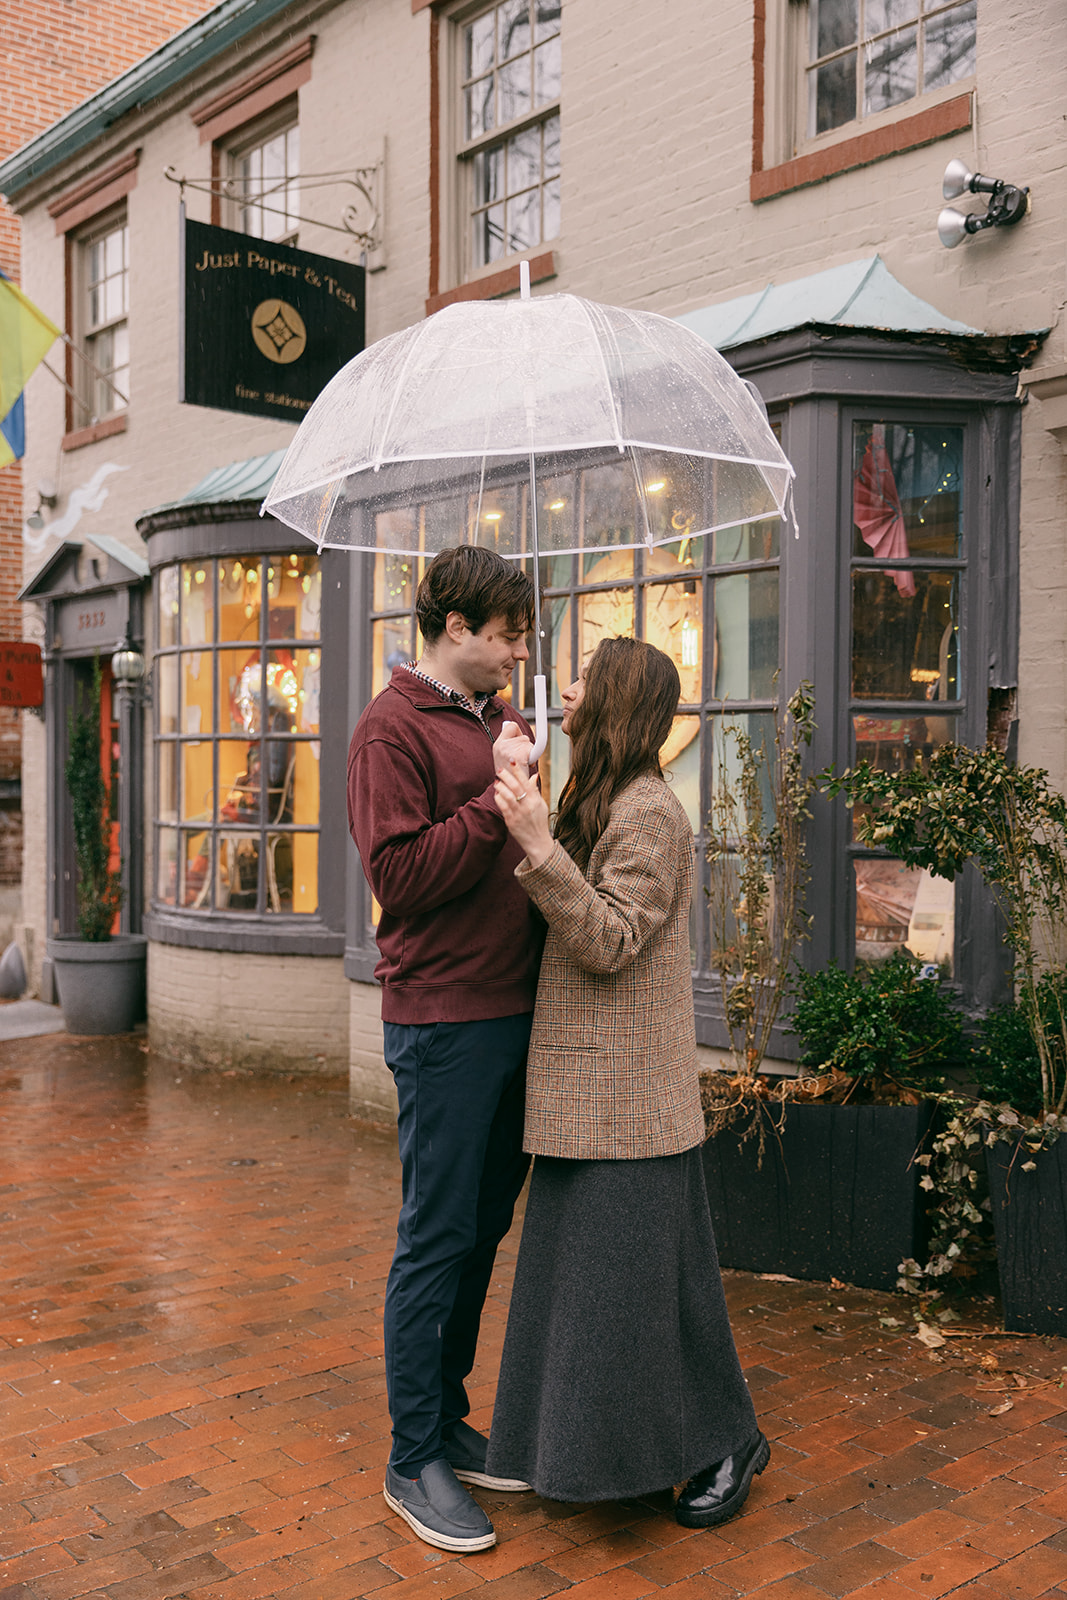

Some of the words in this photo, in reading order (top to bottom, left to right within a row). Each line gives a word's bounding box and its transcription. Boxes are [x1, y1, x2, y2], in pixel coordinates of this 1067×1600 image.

[195, 250, 242, 271] Just
[247, 250, 301, 277] Paper
[304, 266, 322, 287] &
[324, 275, 358, 311] Tea
[235, 383, 260, 400] fine
